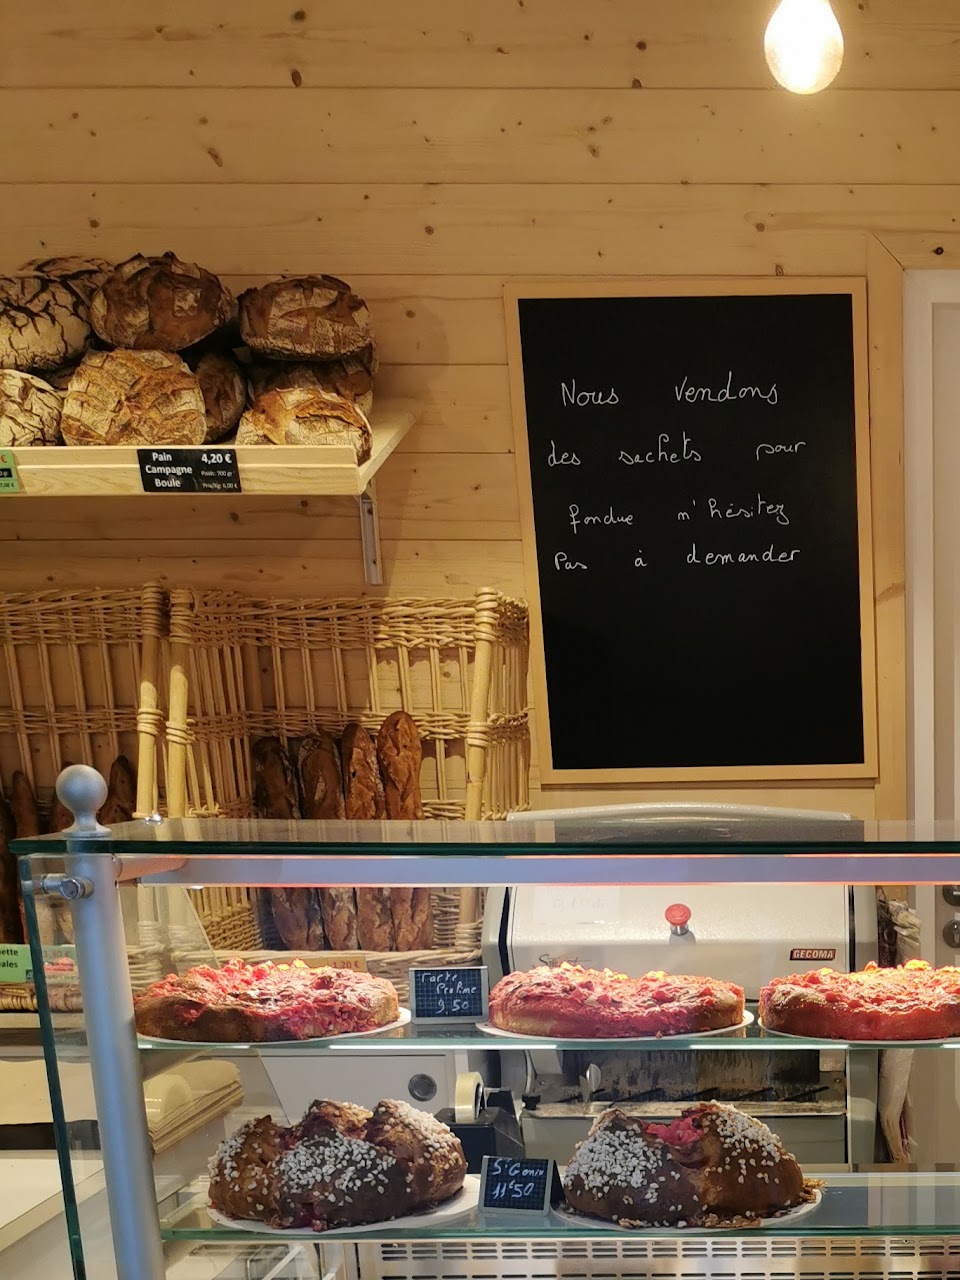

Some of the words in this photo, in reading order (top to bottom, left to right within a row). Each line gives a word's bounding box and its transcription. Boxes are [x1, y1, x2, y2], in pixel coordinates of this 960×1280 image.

[561, 379, 619, 406] Nous
[675, 371, 779, 405] Vendons
[548, 440, 581, 466] des
[618, 431, 702, 464] sachets
[756, 441, 806, 461] pour
[152, 452, 173, 462] Pain
[200, 453, 223, 465] 4,20
[224, 453, 233, 464] €
[145, 464, 193, 476] Campagne
[154, 477, 182, 488] Boule
[569, 503, 634, 534] fondue
[554, 552, 588, 571] Pas
[634, 549, 648, 568] à
[686, 544, 801, 565] demander
[0, 948, 19, 957] ette
[793, 949, 834, 959] GECOMA
[0, 959, 18, 969] ales
[421, 971, 458, 983] Tarte
